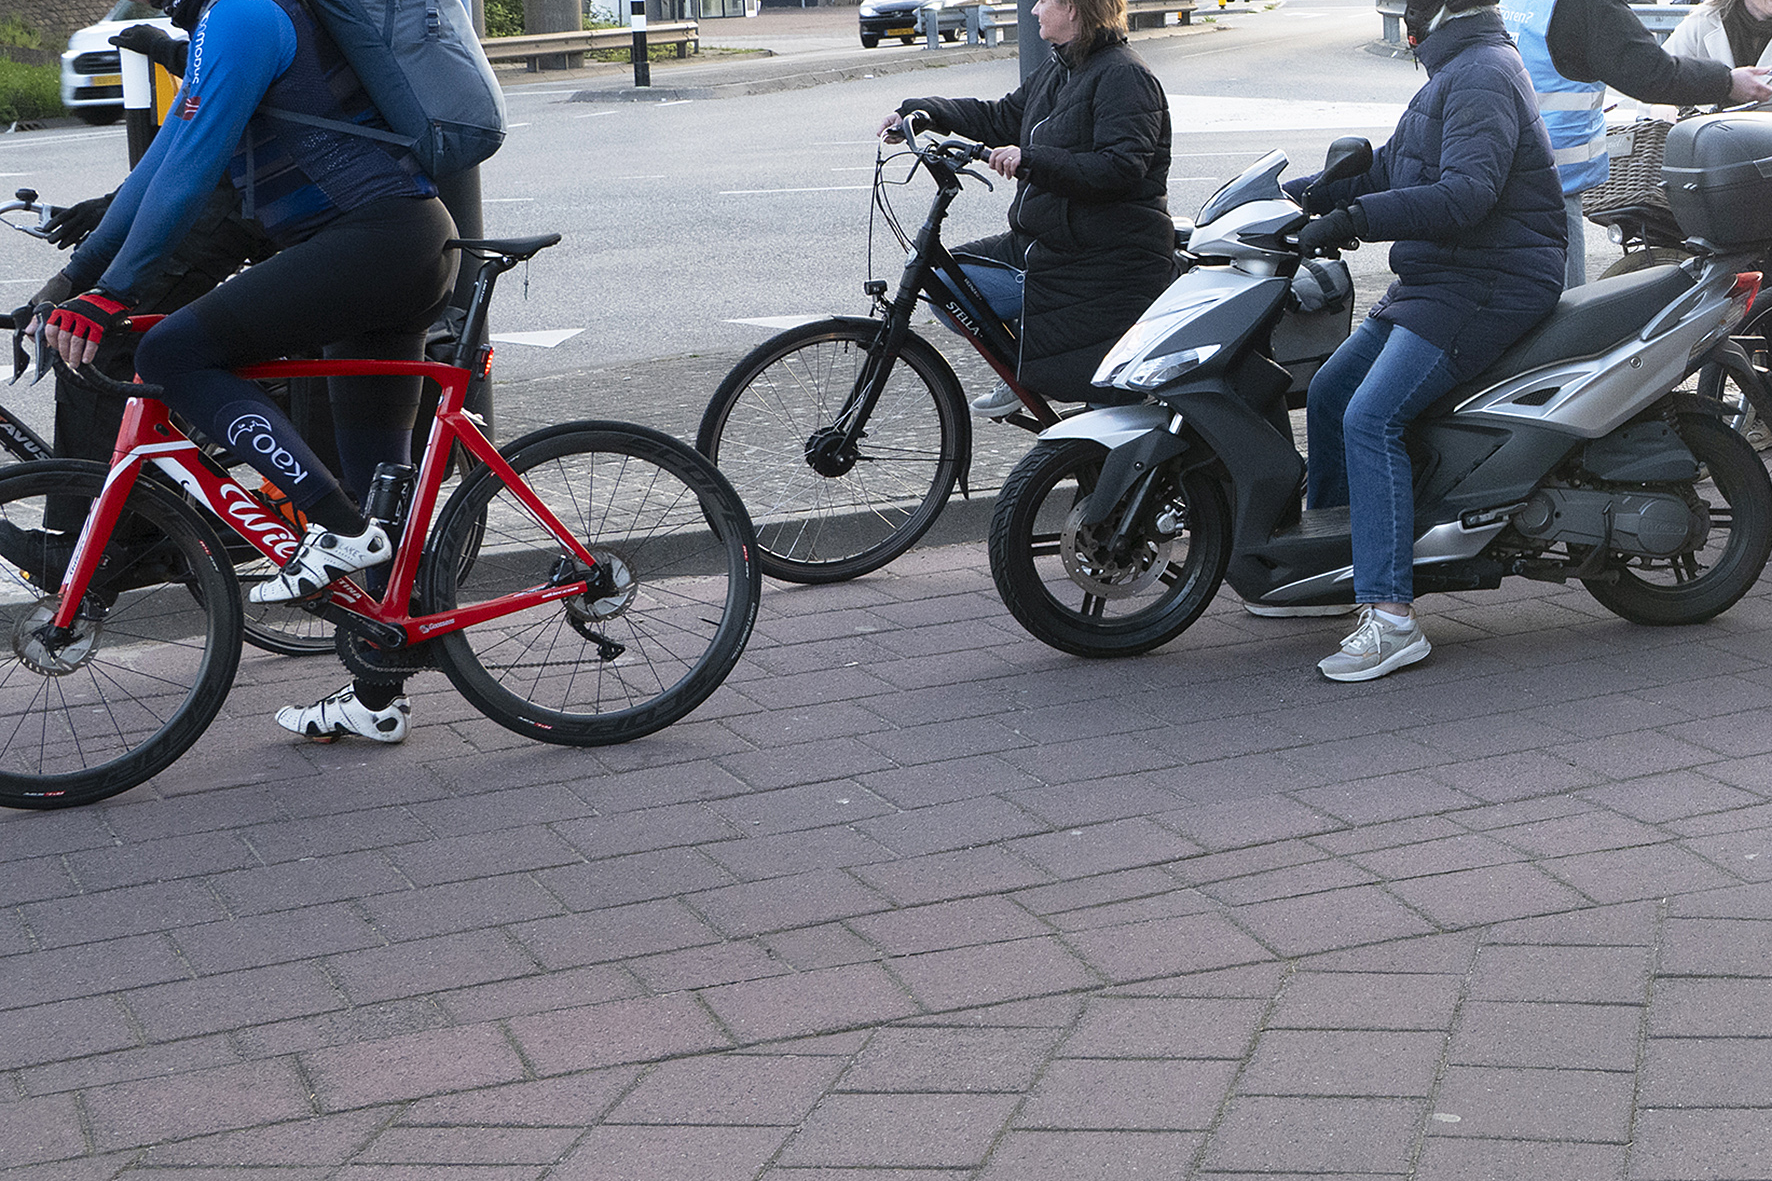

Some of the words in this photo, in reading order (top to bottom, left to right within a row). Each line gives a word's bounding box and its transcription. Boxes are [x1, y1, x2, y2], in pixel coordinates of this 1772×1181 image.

[945, 301, 980, 336] STELLA
[0, 423, 53, 463] AVUS
[252, 433, 309, 485] kao
[220, 483, 299, 559] Wil
[338, 578, 362, 600] TINA
